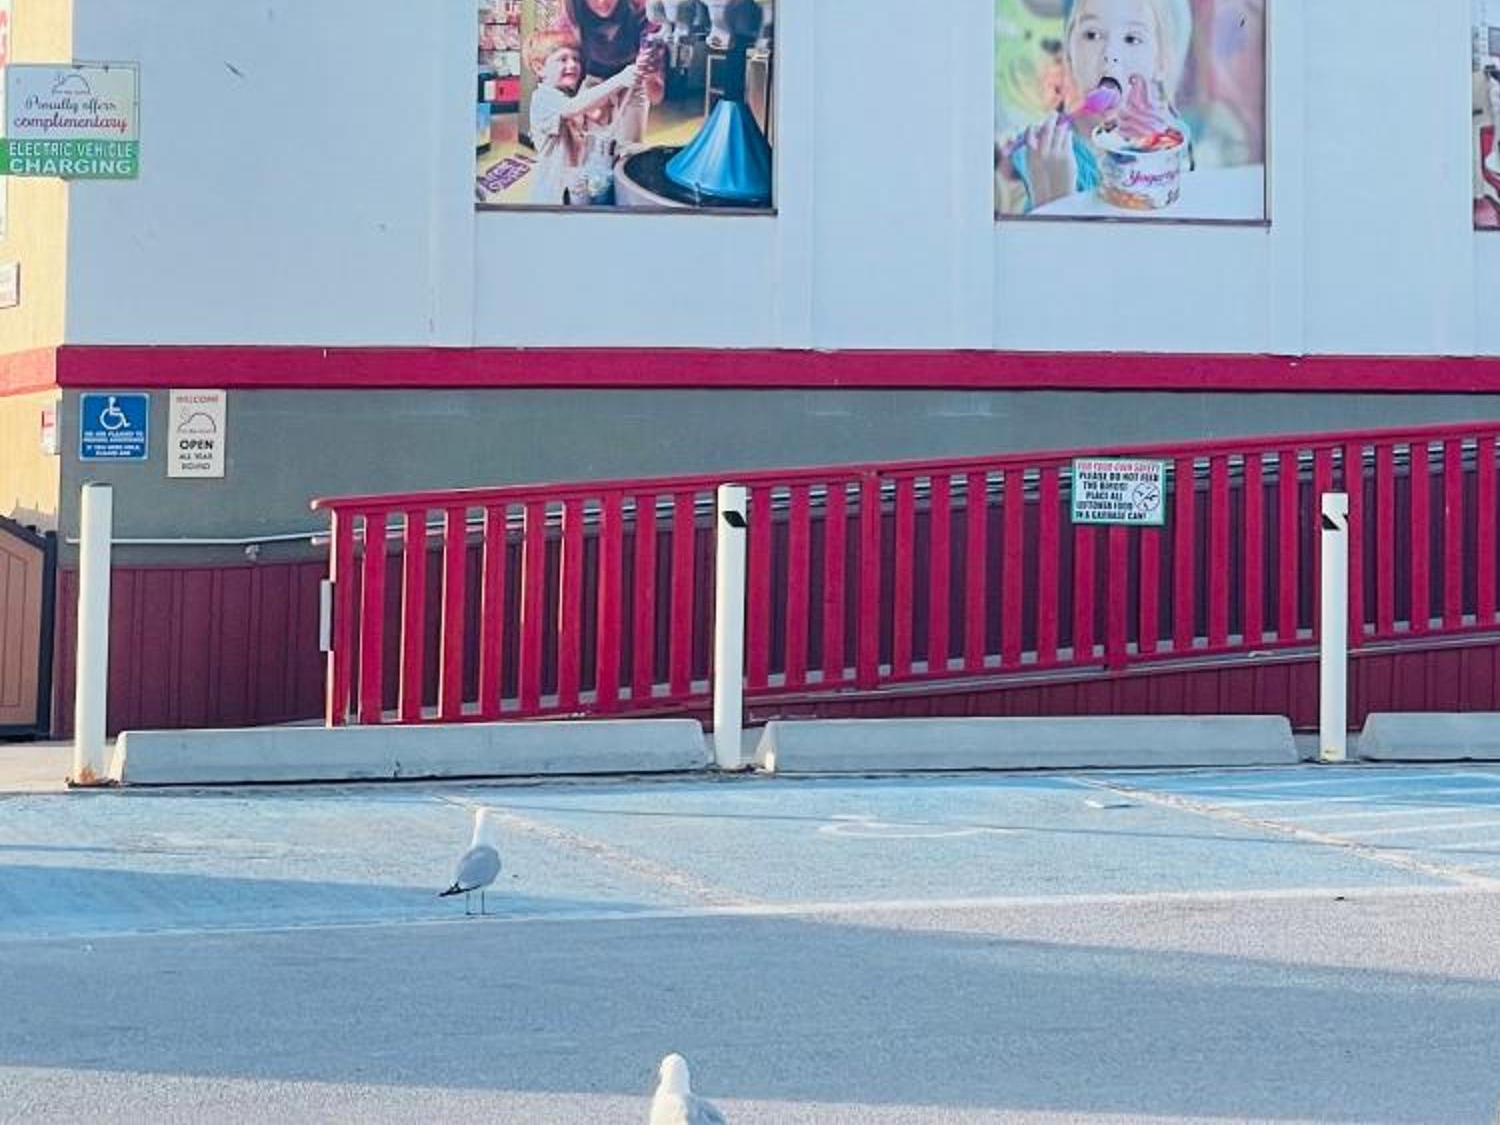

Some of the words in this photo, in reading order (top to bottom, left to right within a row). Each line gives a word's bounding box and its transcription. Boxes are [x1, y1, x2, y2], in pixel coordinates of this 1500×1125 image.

[13, 112, 128, 134] complimentary
[9, 142, 73, 156] ELECTRIC
[77, 143, 134, 158] VEHICLE
[9, 158, 132, 174] CHARGING
[179, 439, 214, 450] OPEN
[1122, 472, 1138, 481] NOT
[1083, 481, 1097, 490] THE
